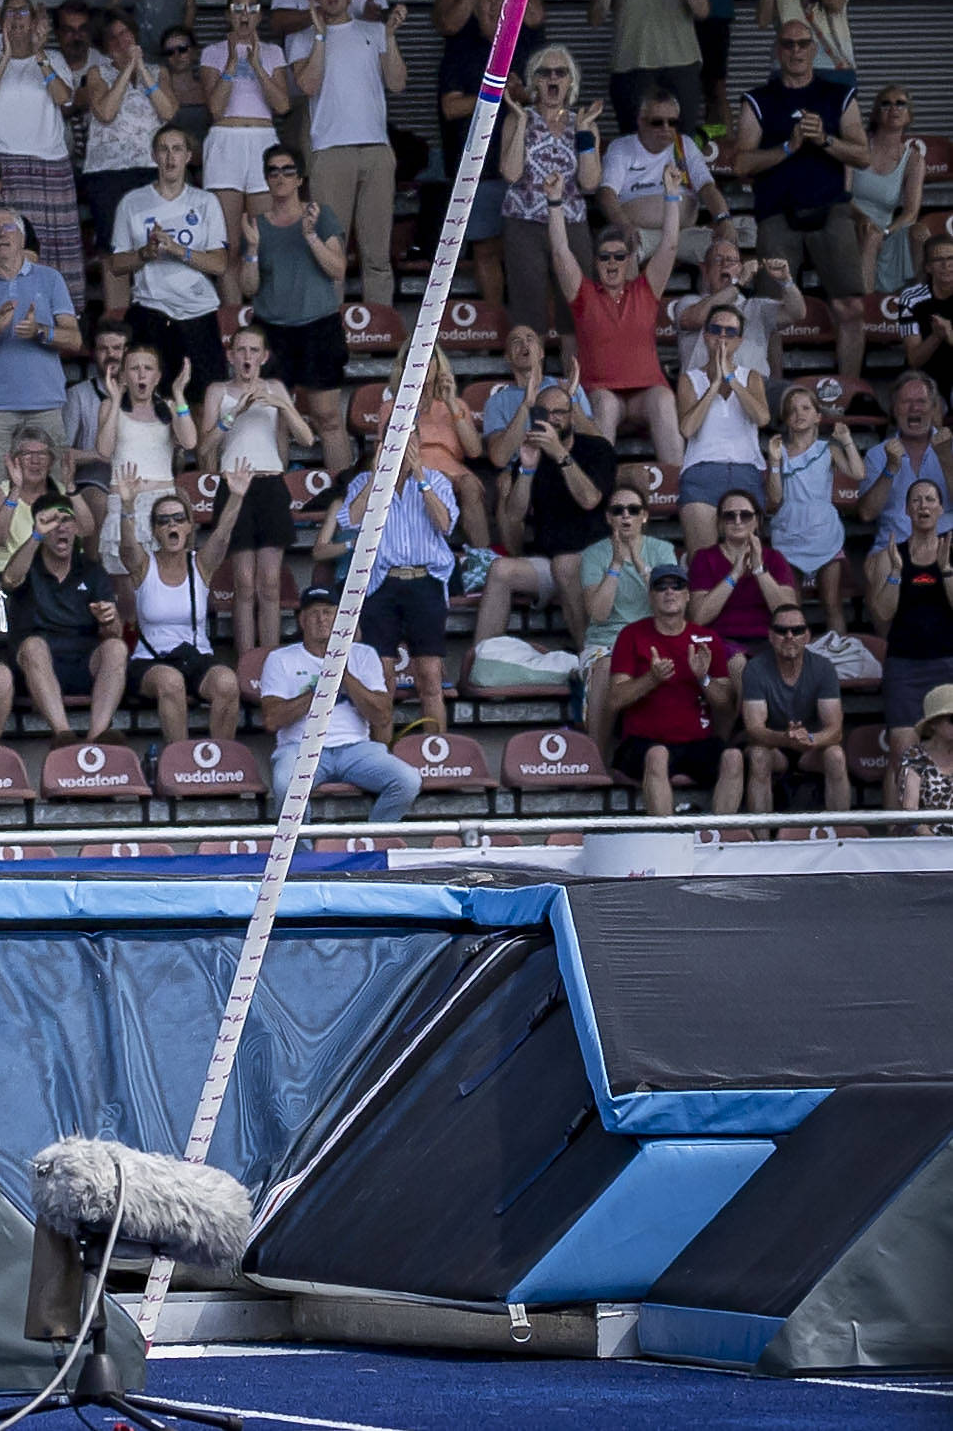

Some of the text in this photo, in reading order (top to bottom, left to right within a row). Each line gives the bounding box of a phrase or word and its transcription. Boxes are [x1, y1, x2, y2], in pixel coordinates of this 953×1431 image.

[420, 764, 473, 777] dafone
[520, 762, 590, 775] vodafone
[57, 774, 129, 787] vodafone
[173, 770, 244, 783] vodafone
